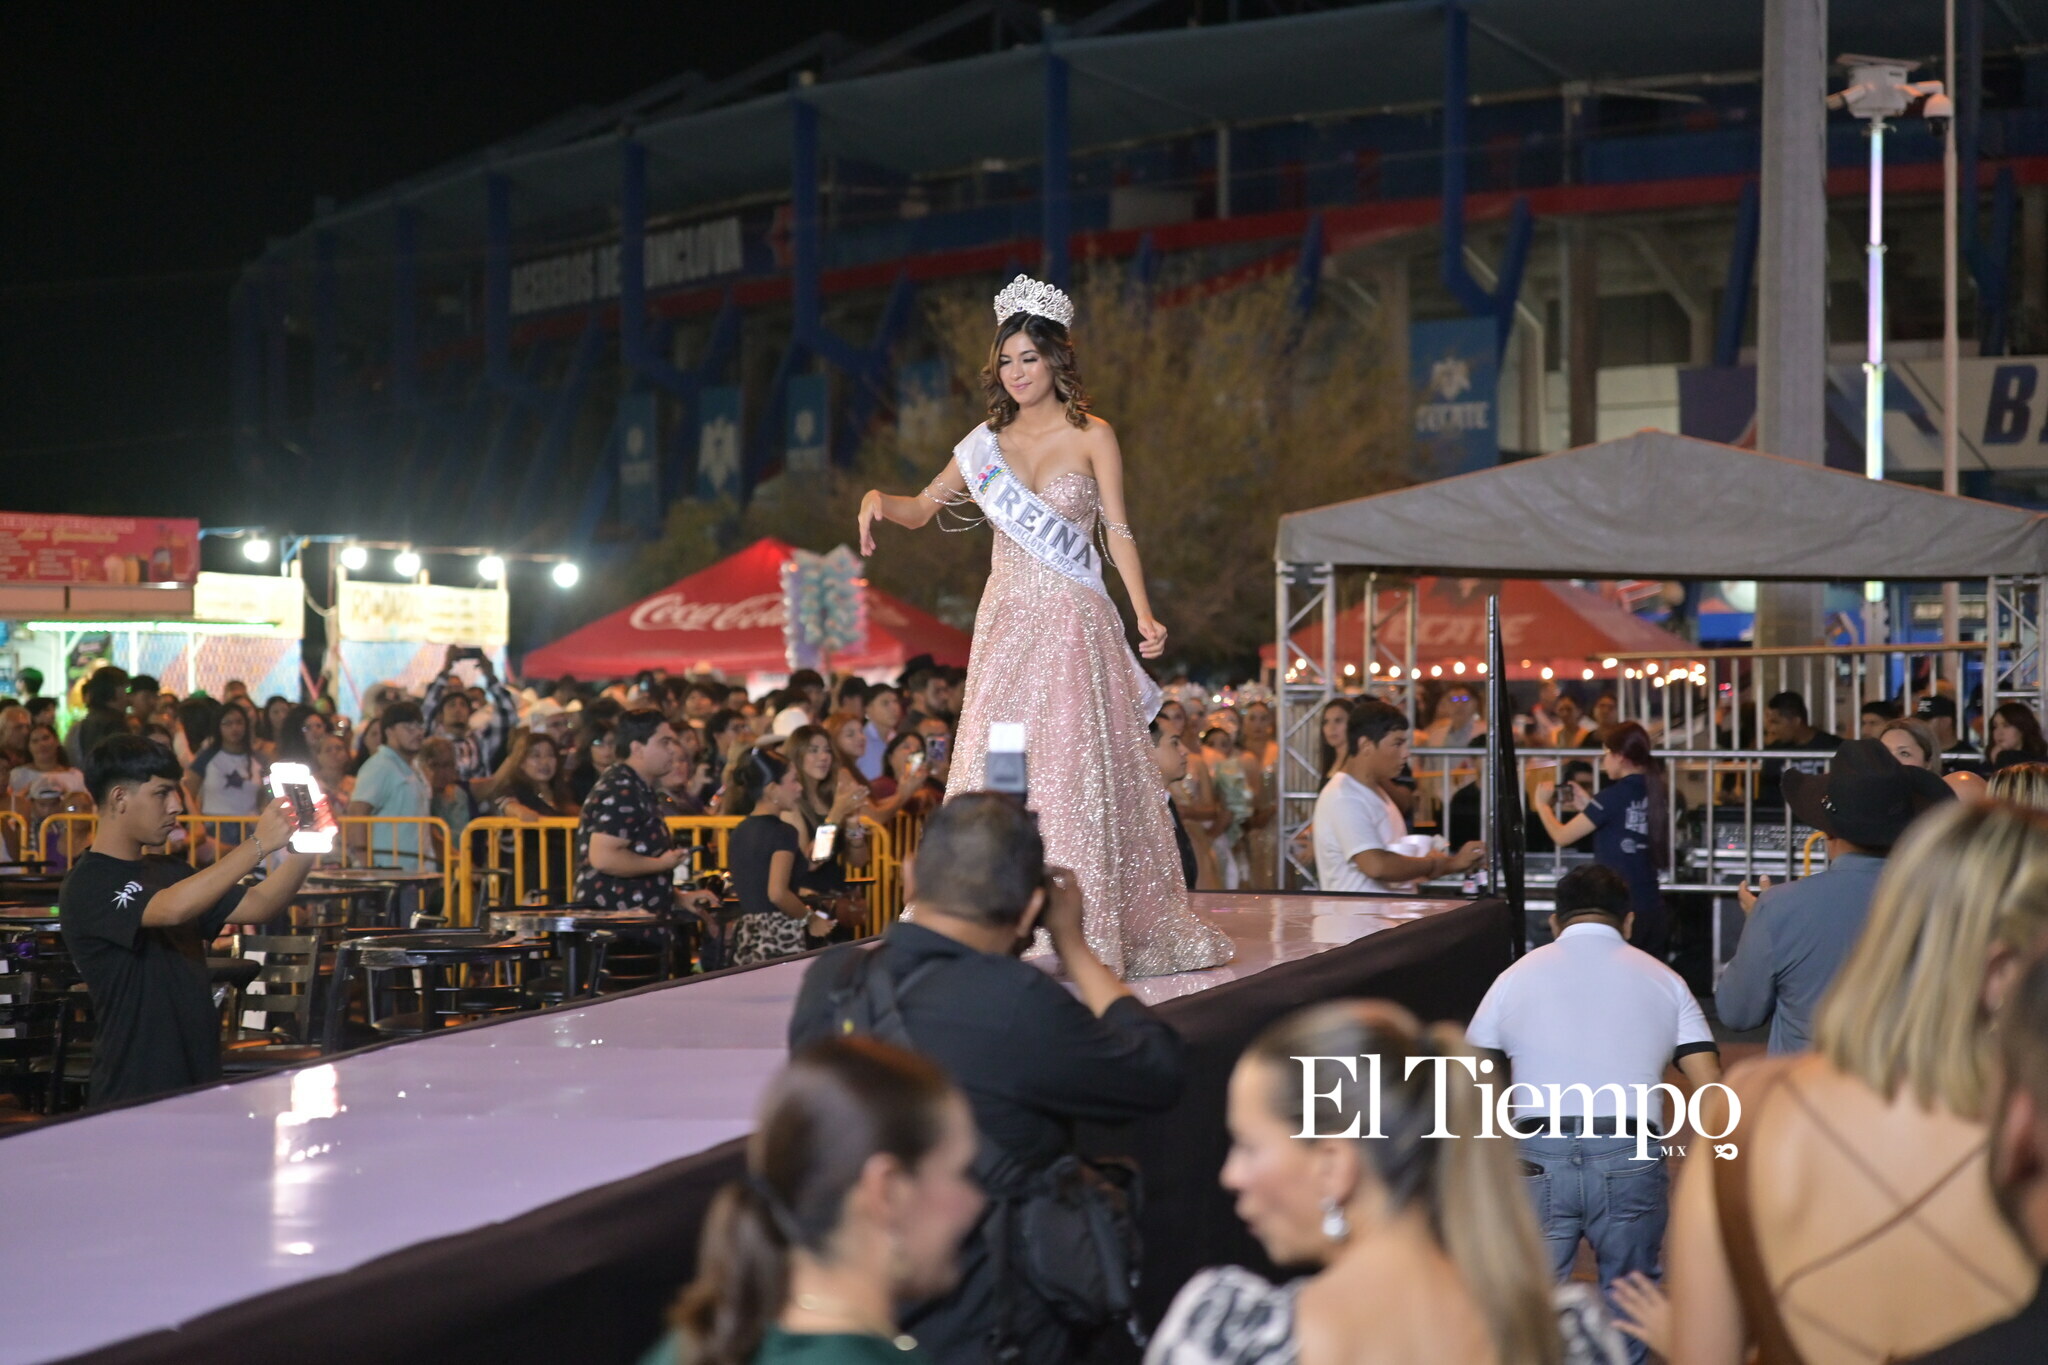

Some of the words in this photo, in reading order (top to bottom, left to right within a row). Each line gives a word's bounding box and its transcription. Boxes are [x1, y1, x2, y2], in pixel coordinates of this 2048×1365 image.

[1984, 364, 2048, 444] B
[994, 483, 1091, 570] REINA
[1004, 518, 1048, 557] MONCLOVA
[1053, 551, 1075, 573] 2025
[629, 592, 785, 631] Coca-Col
